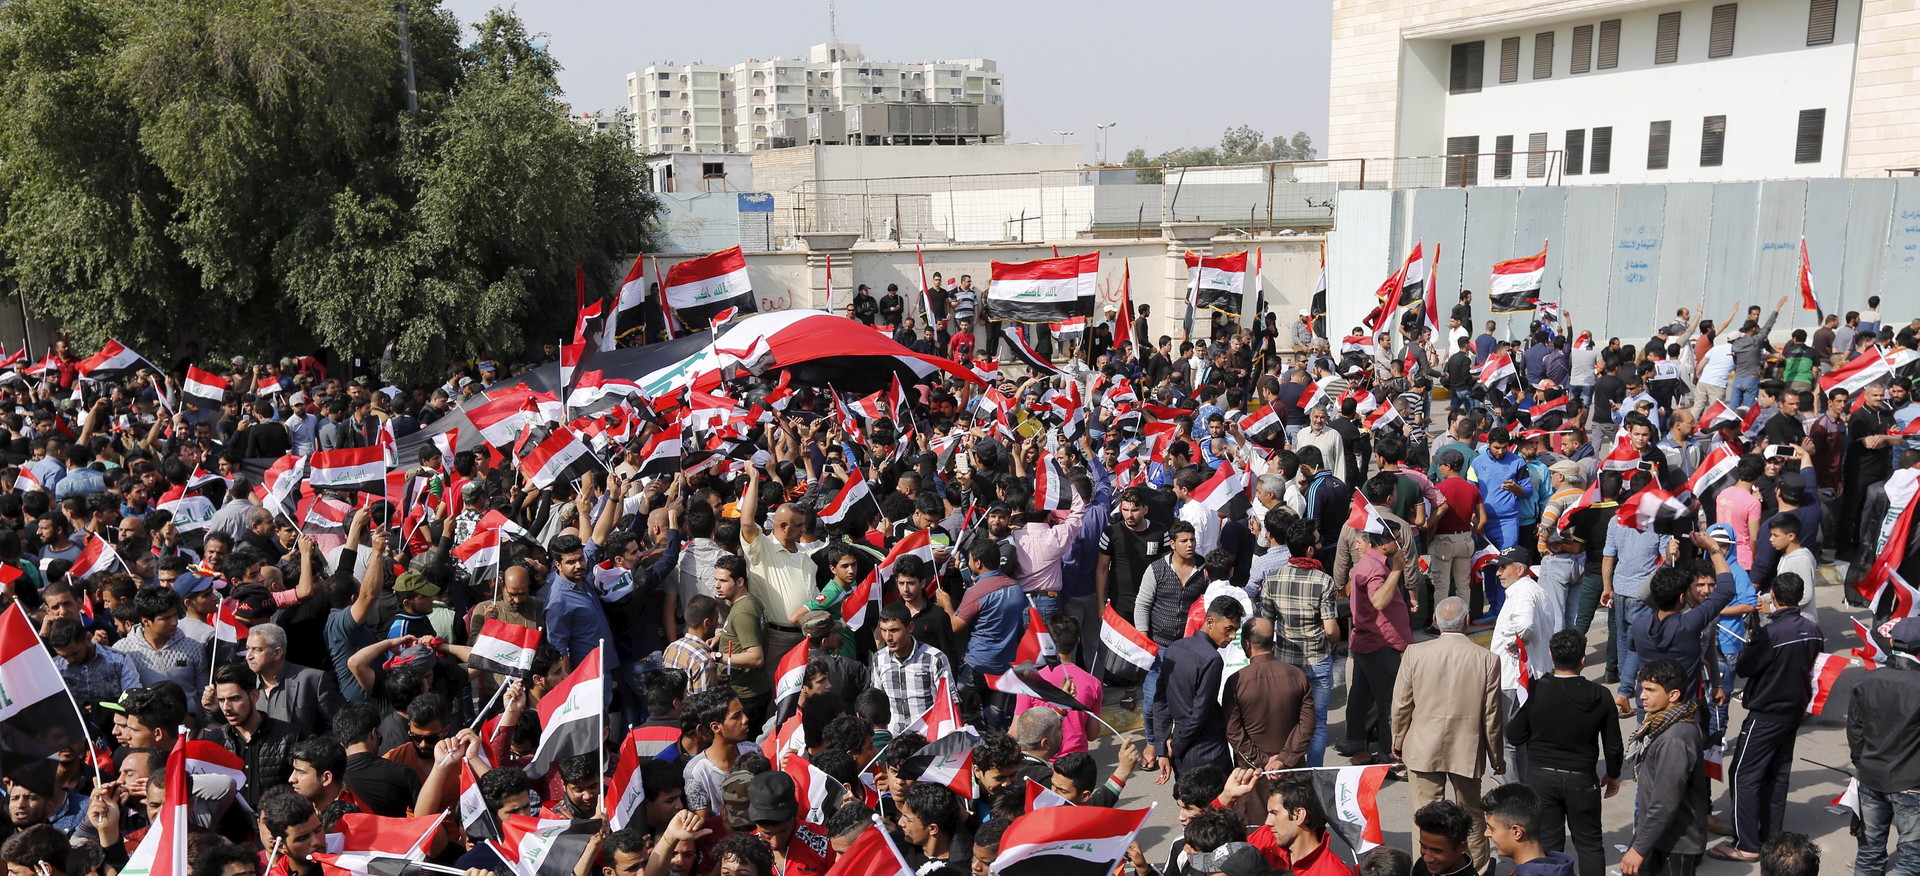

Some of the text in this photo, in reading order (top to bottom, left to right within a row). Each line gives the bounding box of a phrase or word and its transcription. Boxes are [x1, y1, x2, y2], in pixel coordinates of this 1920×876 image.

[713, 282, 729, 296] الله
[1045, 285, 1057, 296] الله
[1071, 843, 1093, 852] الله
